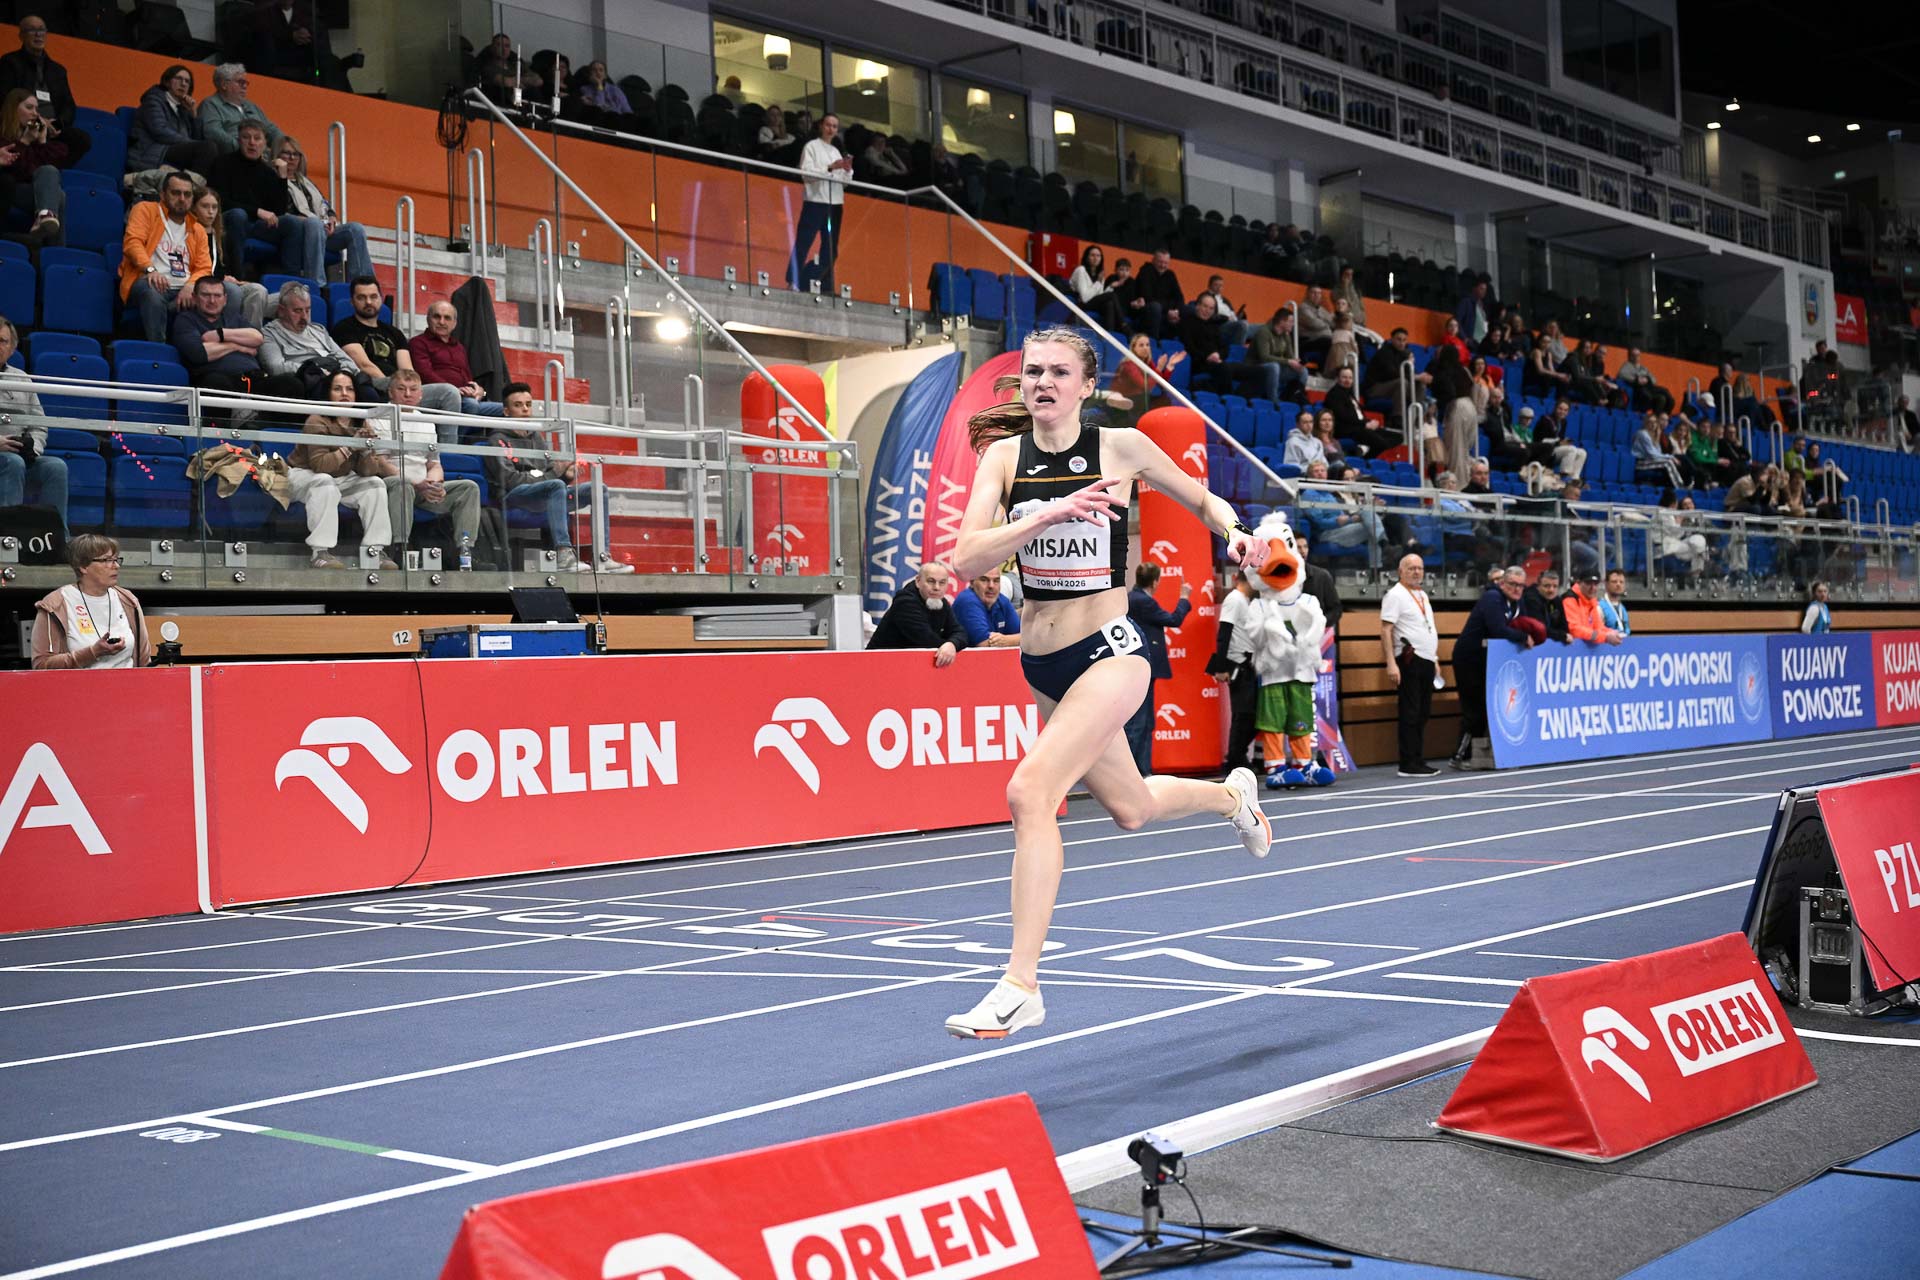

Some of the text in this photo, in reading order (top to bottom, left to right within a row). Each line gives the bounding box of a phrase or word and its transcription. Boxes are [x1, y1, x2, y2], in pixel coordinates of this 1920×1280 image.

[762, 449, 819, 463] ORLEN
[1023, 538, 1097, 558] MISJAN
[1036, 578, 1063, 587] TORUŃ
[1160, 566, 1183, 577] LEN
[394, 631, 410, 644] 12
[1110, 624, 1130, 649] 9
[1781, 646, 1848, 682] KUJAWY
[1882, 642, 1920, 675] KUJA
[1535, 651, 1733, 694] KUJAWSKO-POMORSKI
[1782, 684, 1864, 723] POMORZE
[1536, 696, 1736, 746] ZWIĄZEK LEKKIEJ ATLETYKI
[866, 703, 1038, 770] ORLEN
[1154, 729, 1191, 741] ORLEN
[436, 720, 679, 803] ORLEN
[496, 911, 665, 927] 5
[671, 922, 829, 938] 4
[1099, 947, 1335, 972] 2
[1667, 992, 1774, 1062] ORLEN
[792, 1188, 1017, 1280] ORLEN
